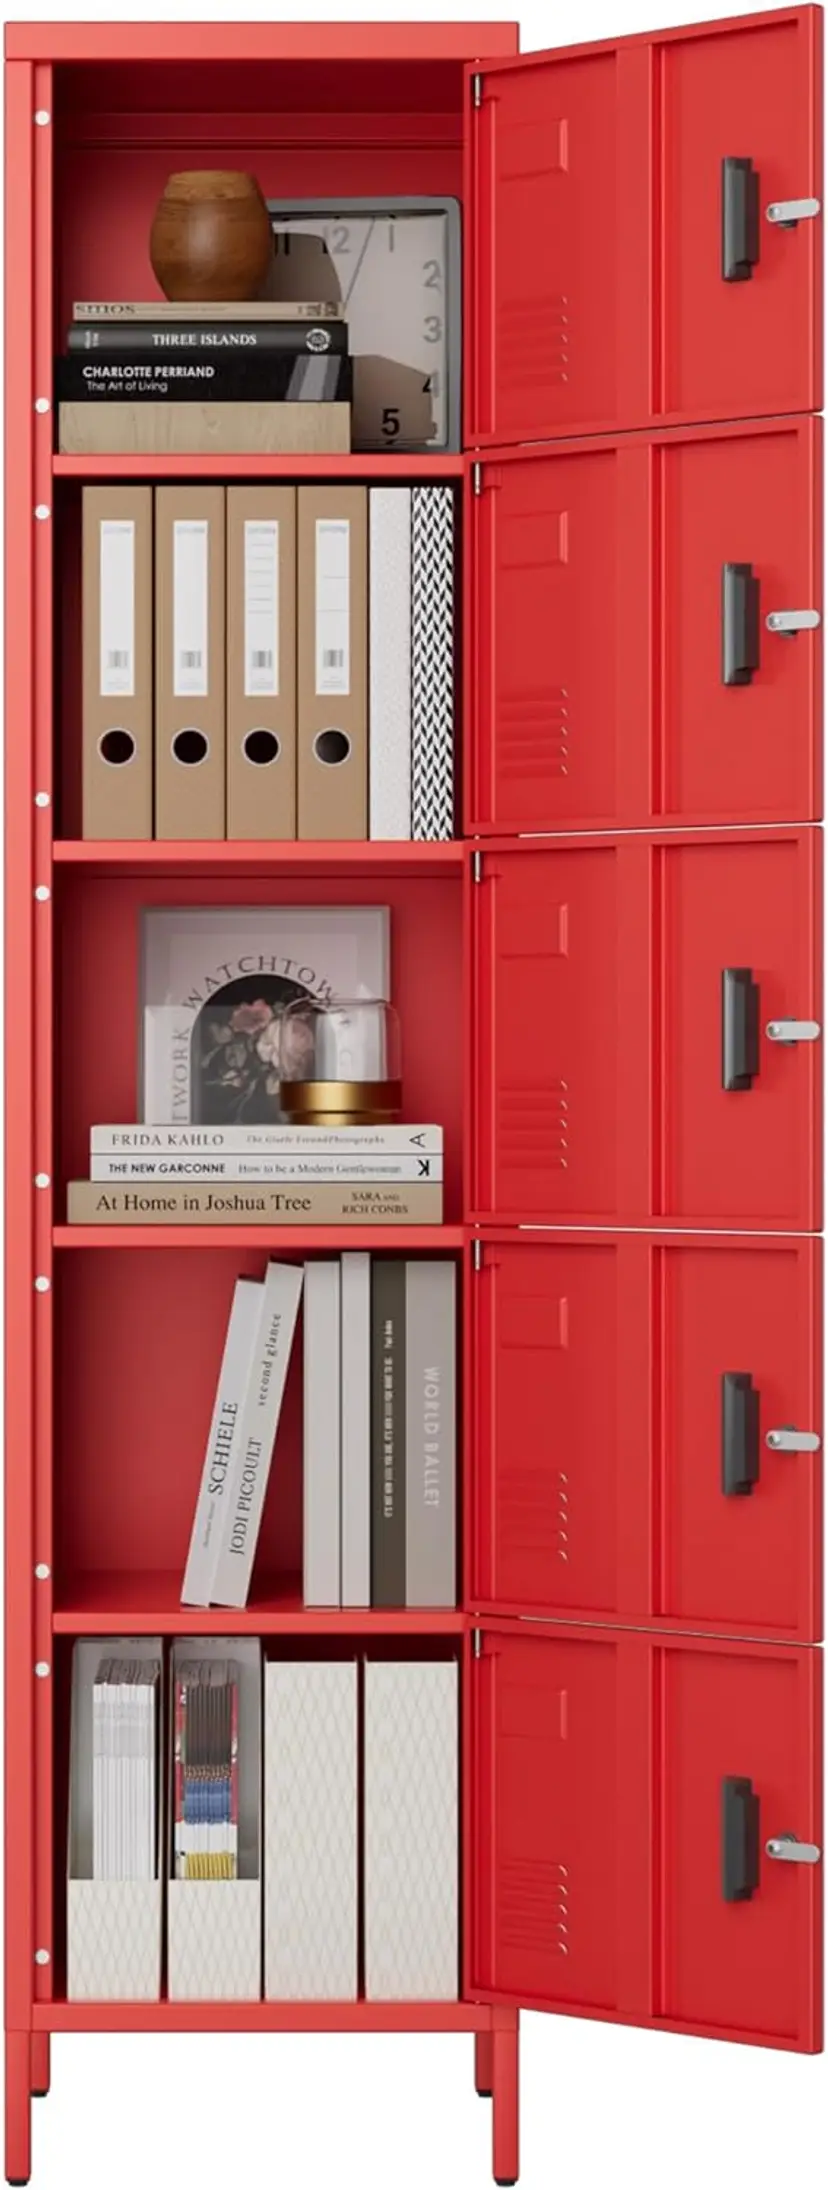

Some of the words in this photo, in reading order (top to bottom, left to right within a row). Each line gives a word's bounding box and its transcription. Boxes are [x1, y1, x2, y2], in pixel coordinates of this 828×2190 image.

[322, 226, 350, 254] 12
[422, 260, 441, 288] 2
[152, 334, 196, 346] THREE
[200, 333, 257, 346] ISLANDS
[423, 316, 442, 343] 3
[82, 366, 152, 378] CHARLOTTE
[154, 366, 215, 378] PERRIAND
[87, 381, 105, 391] The
[108, 381, 121, 391] Art
[125, 381, 136, 391] of
[138, 381, 168, 393] Living
[381, 408, 400, 436] 5
[112, 1134, 162, 1146] FRIDA
[168, 1134, 224, 1146] KAHLO
[109, 1163, 128, 1173] THE
[131, 1163, 155, 1173] NEW
[159, 1163, 225, 1174] GARCONNE
[238, 1164, 260, 1174] How
[264, 1164, 273, 1174] to
[275, 1164, 287, 1174] be
[289, 1166, 295, 1174] a
[298, 1163, 334, 1174] Modern
[418, 1159, 430, 1176] K
[96, 1194, 117, 1211] At
[124, 1194, 177, 1211] Home
[184, 1194, 199, 1211] in
[205, 1194, 266, 1212] Joshua
[271, 1193, 312, 1211] Tree
[258, 1360, 273, 1407] second
[266, 1313, 282, 1358] glance
[423, 1366, 441, 1435] WORLD
[208, 1402, 239, 1496] SCHIELE
[237, 1437, 262, 1513] PICOULT
[423, 1442, 441, 1509] BALLET
[229, 1512, 248, 1556] JODI
